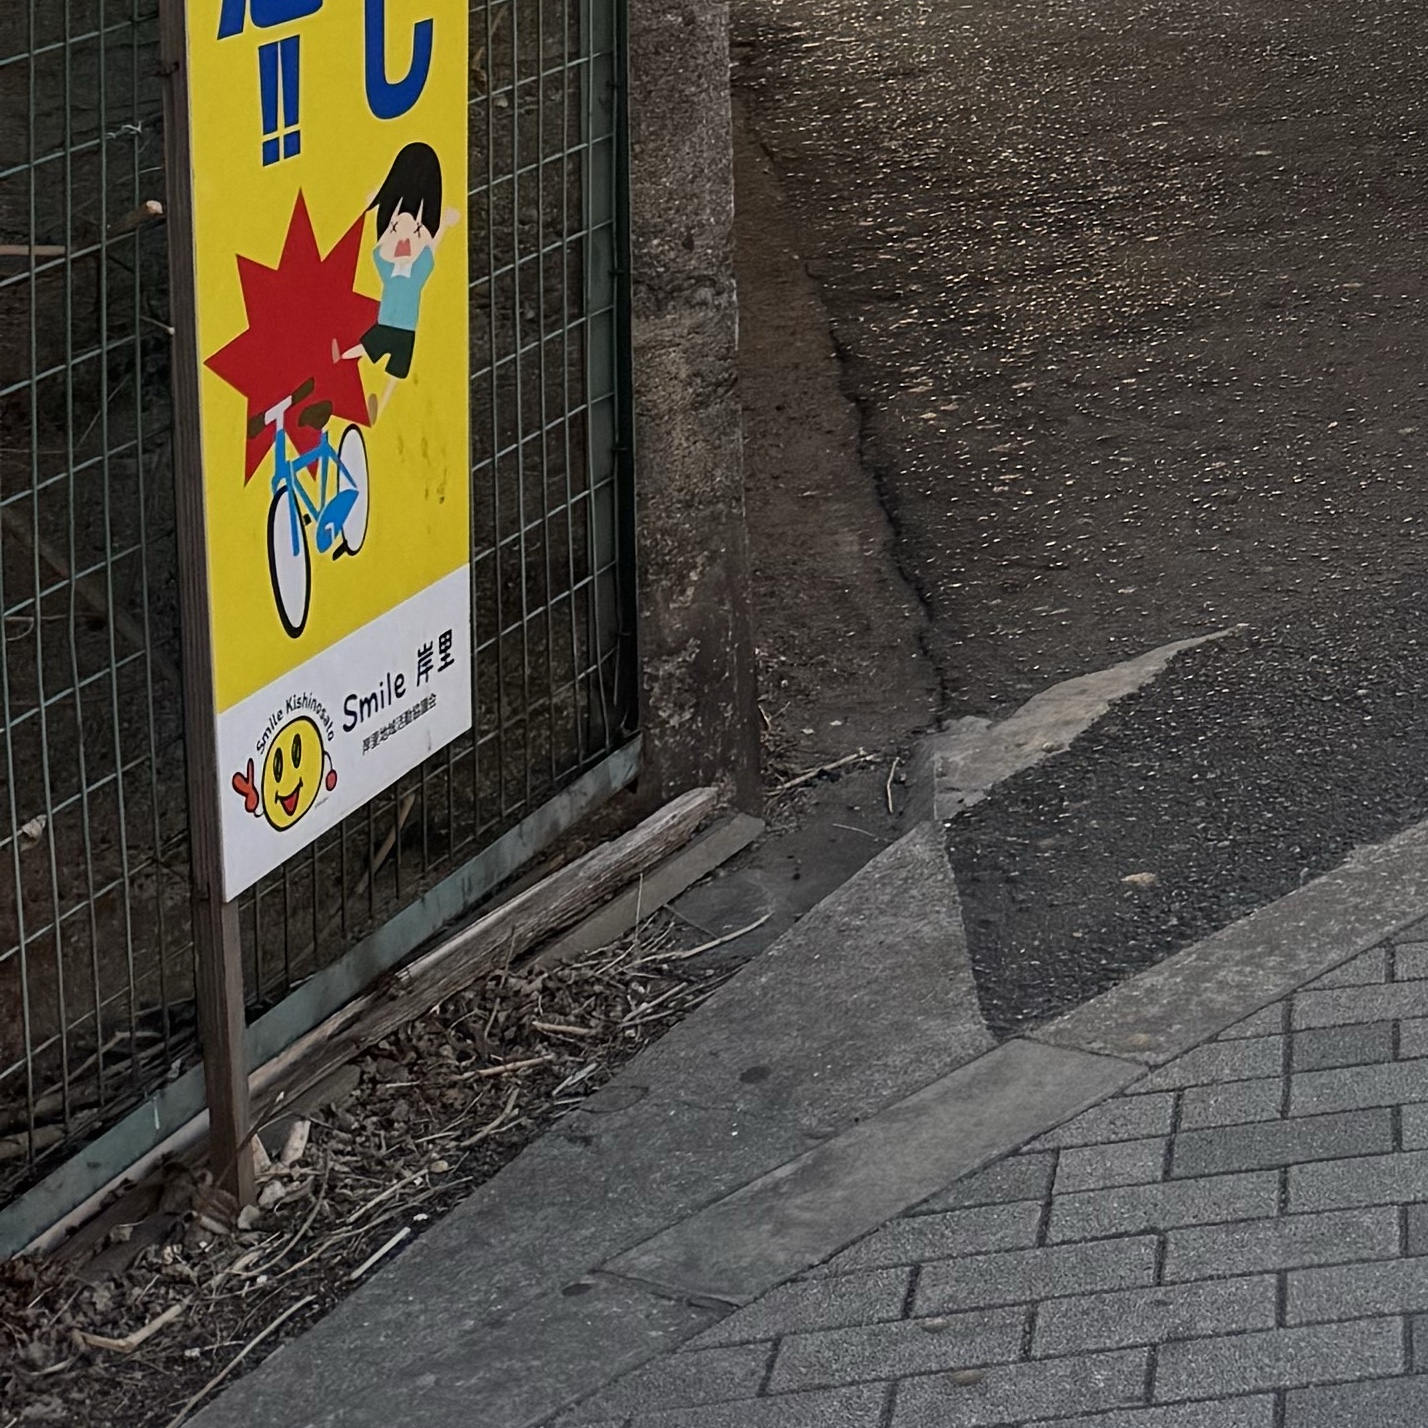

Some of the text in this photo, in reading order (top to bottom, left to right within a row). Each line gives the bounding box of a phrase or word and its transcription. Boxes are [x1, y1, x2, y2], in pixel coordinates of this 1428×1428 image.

[343, 629, 455, 732] Smile 岸里
[256, 692, 335, 755] Smile Kishinosato
